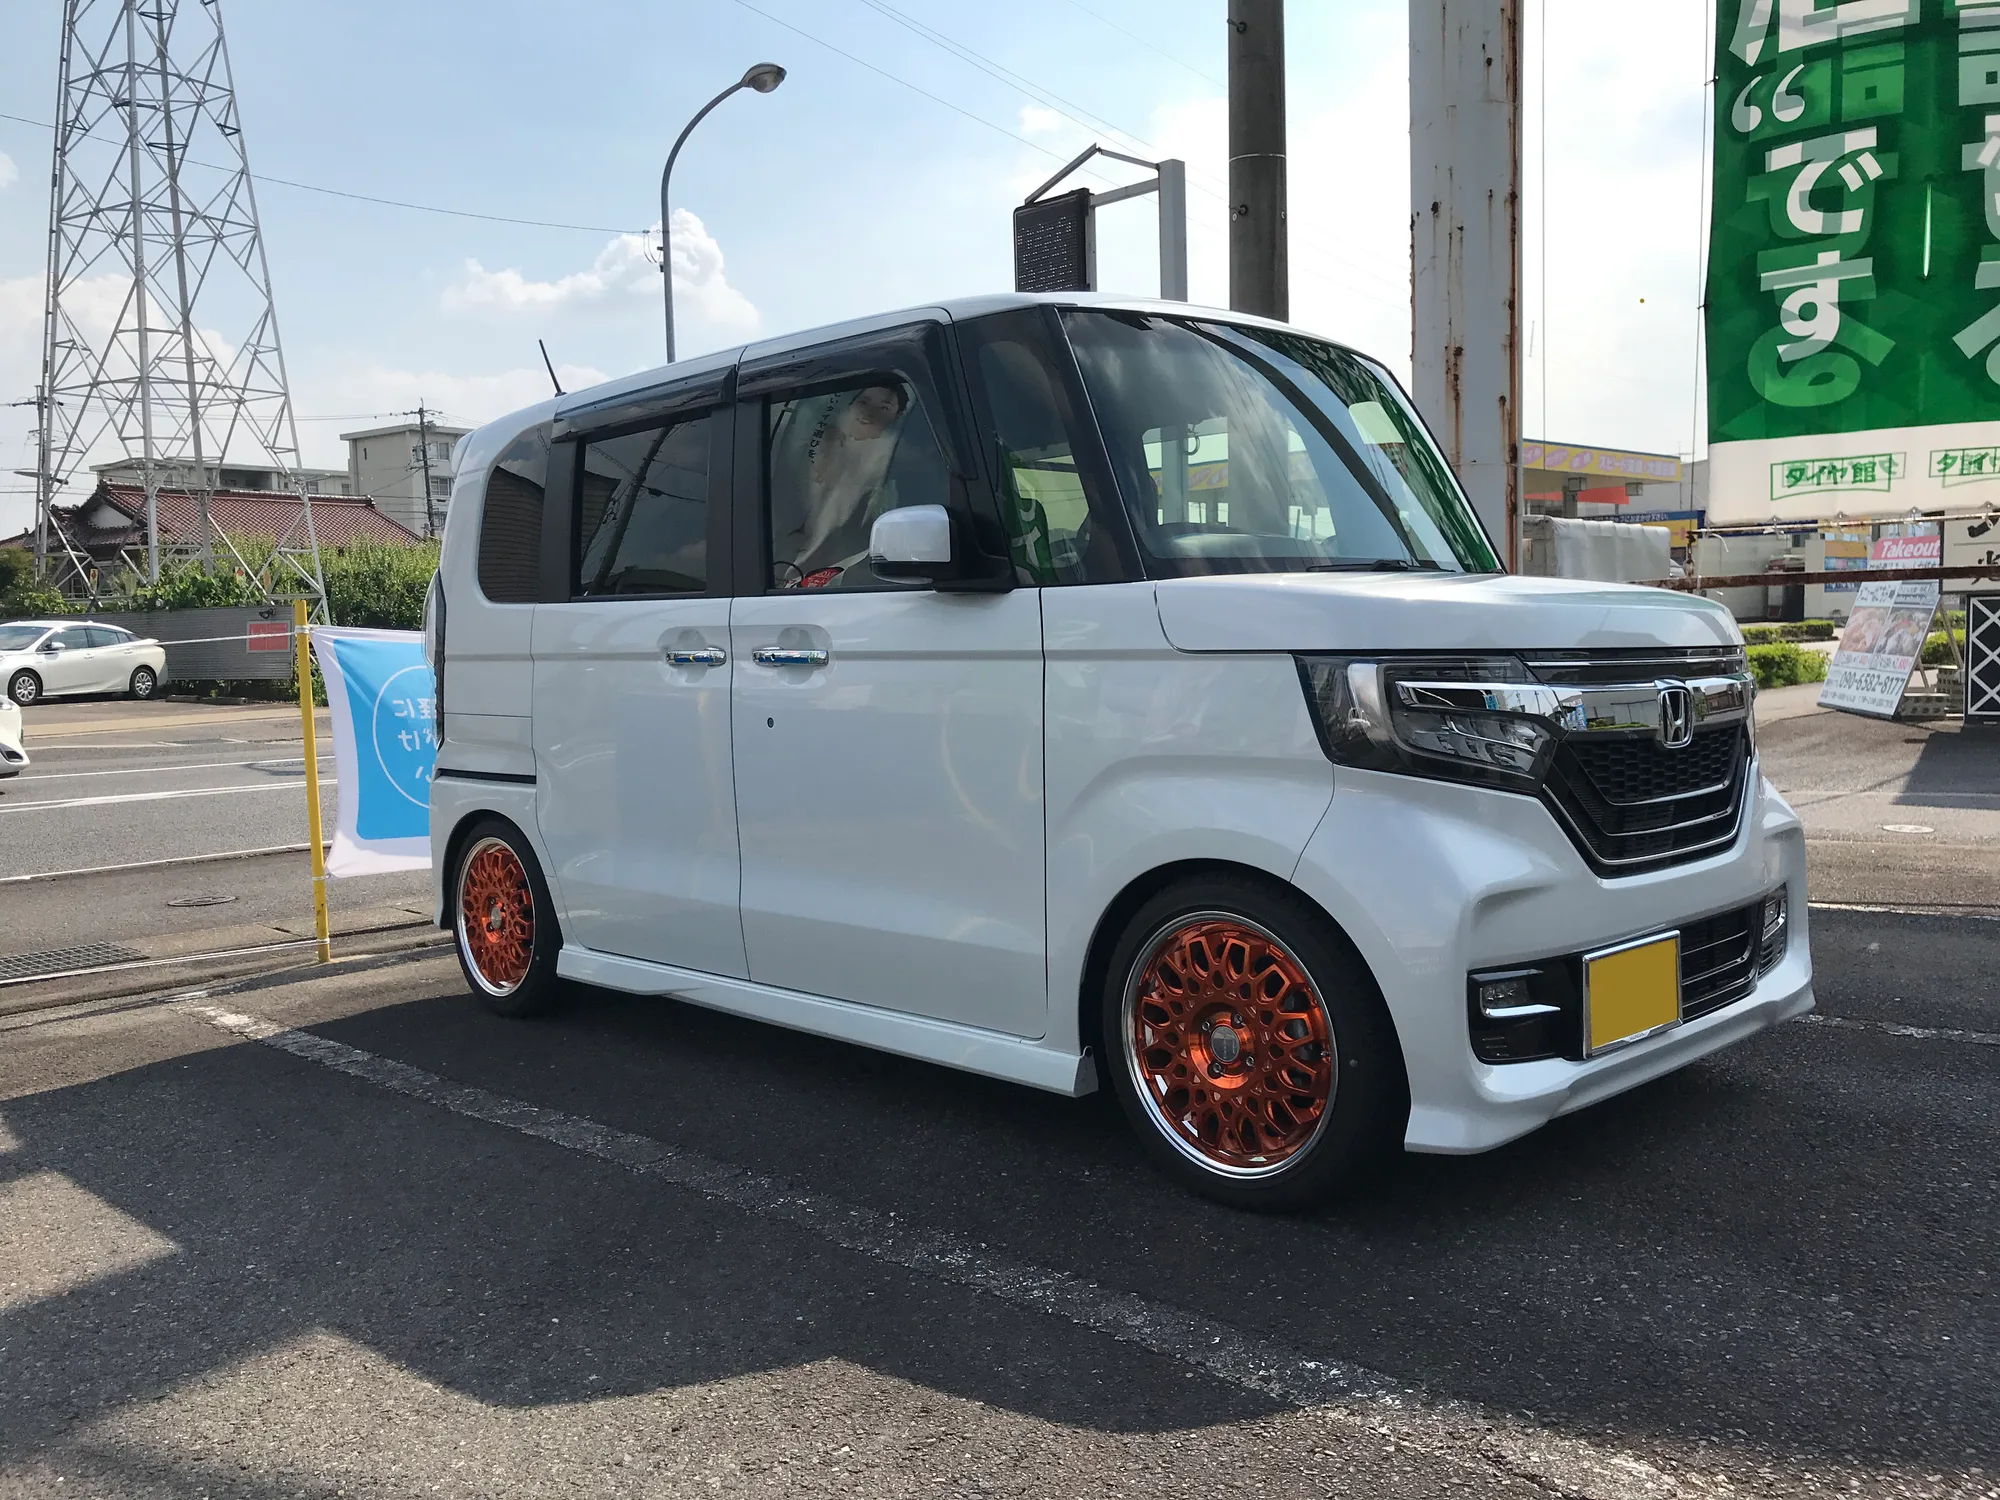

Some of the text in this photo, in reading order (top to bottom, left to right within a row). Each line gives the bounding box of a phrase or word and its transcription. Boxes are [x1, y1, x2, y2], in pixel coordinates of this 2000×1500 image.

[1786, 461, 1877, 489] タイヤ館
[1881, 539, 1940, 558] Takeout
[1839, 671, 1906, 696] 090-6582-8177
